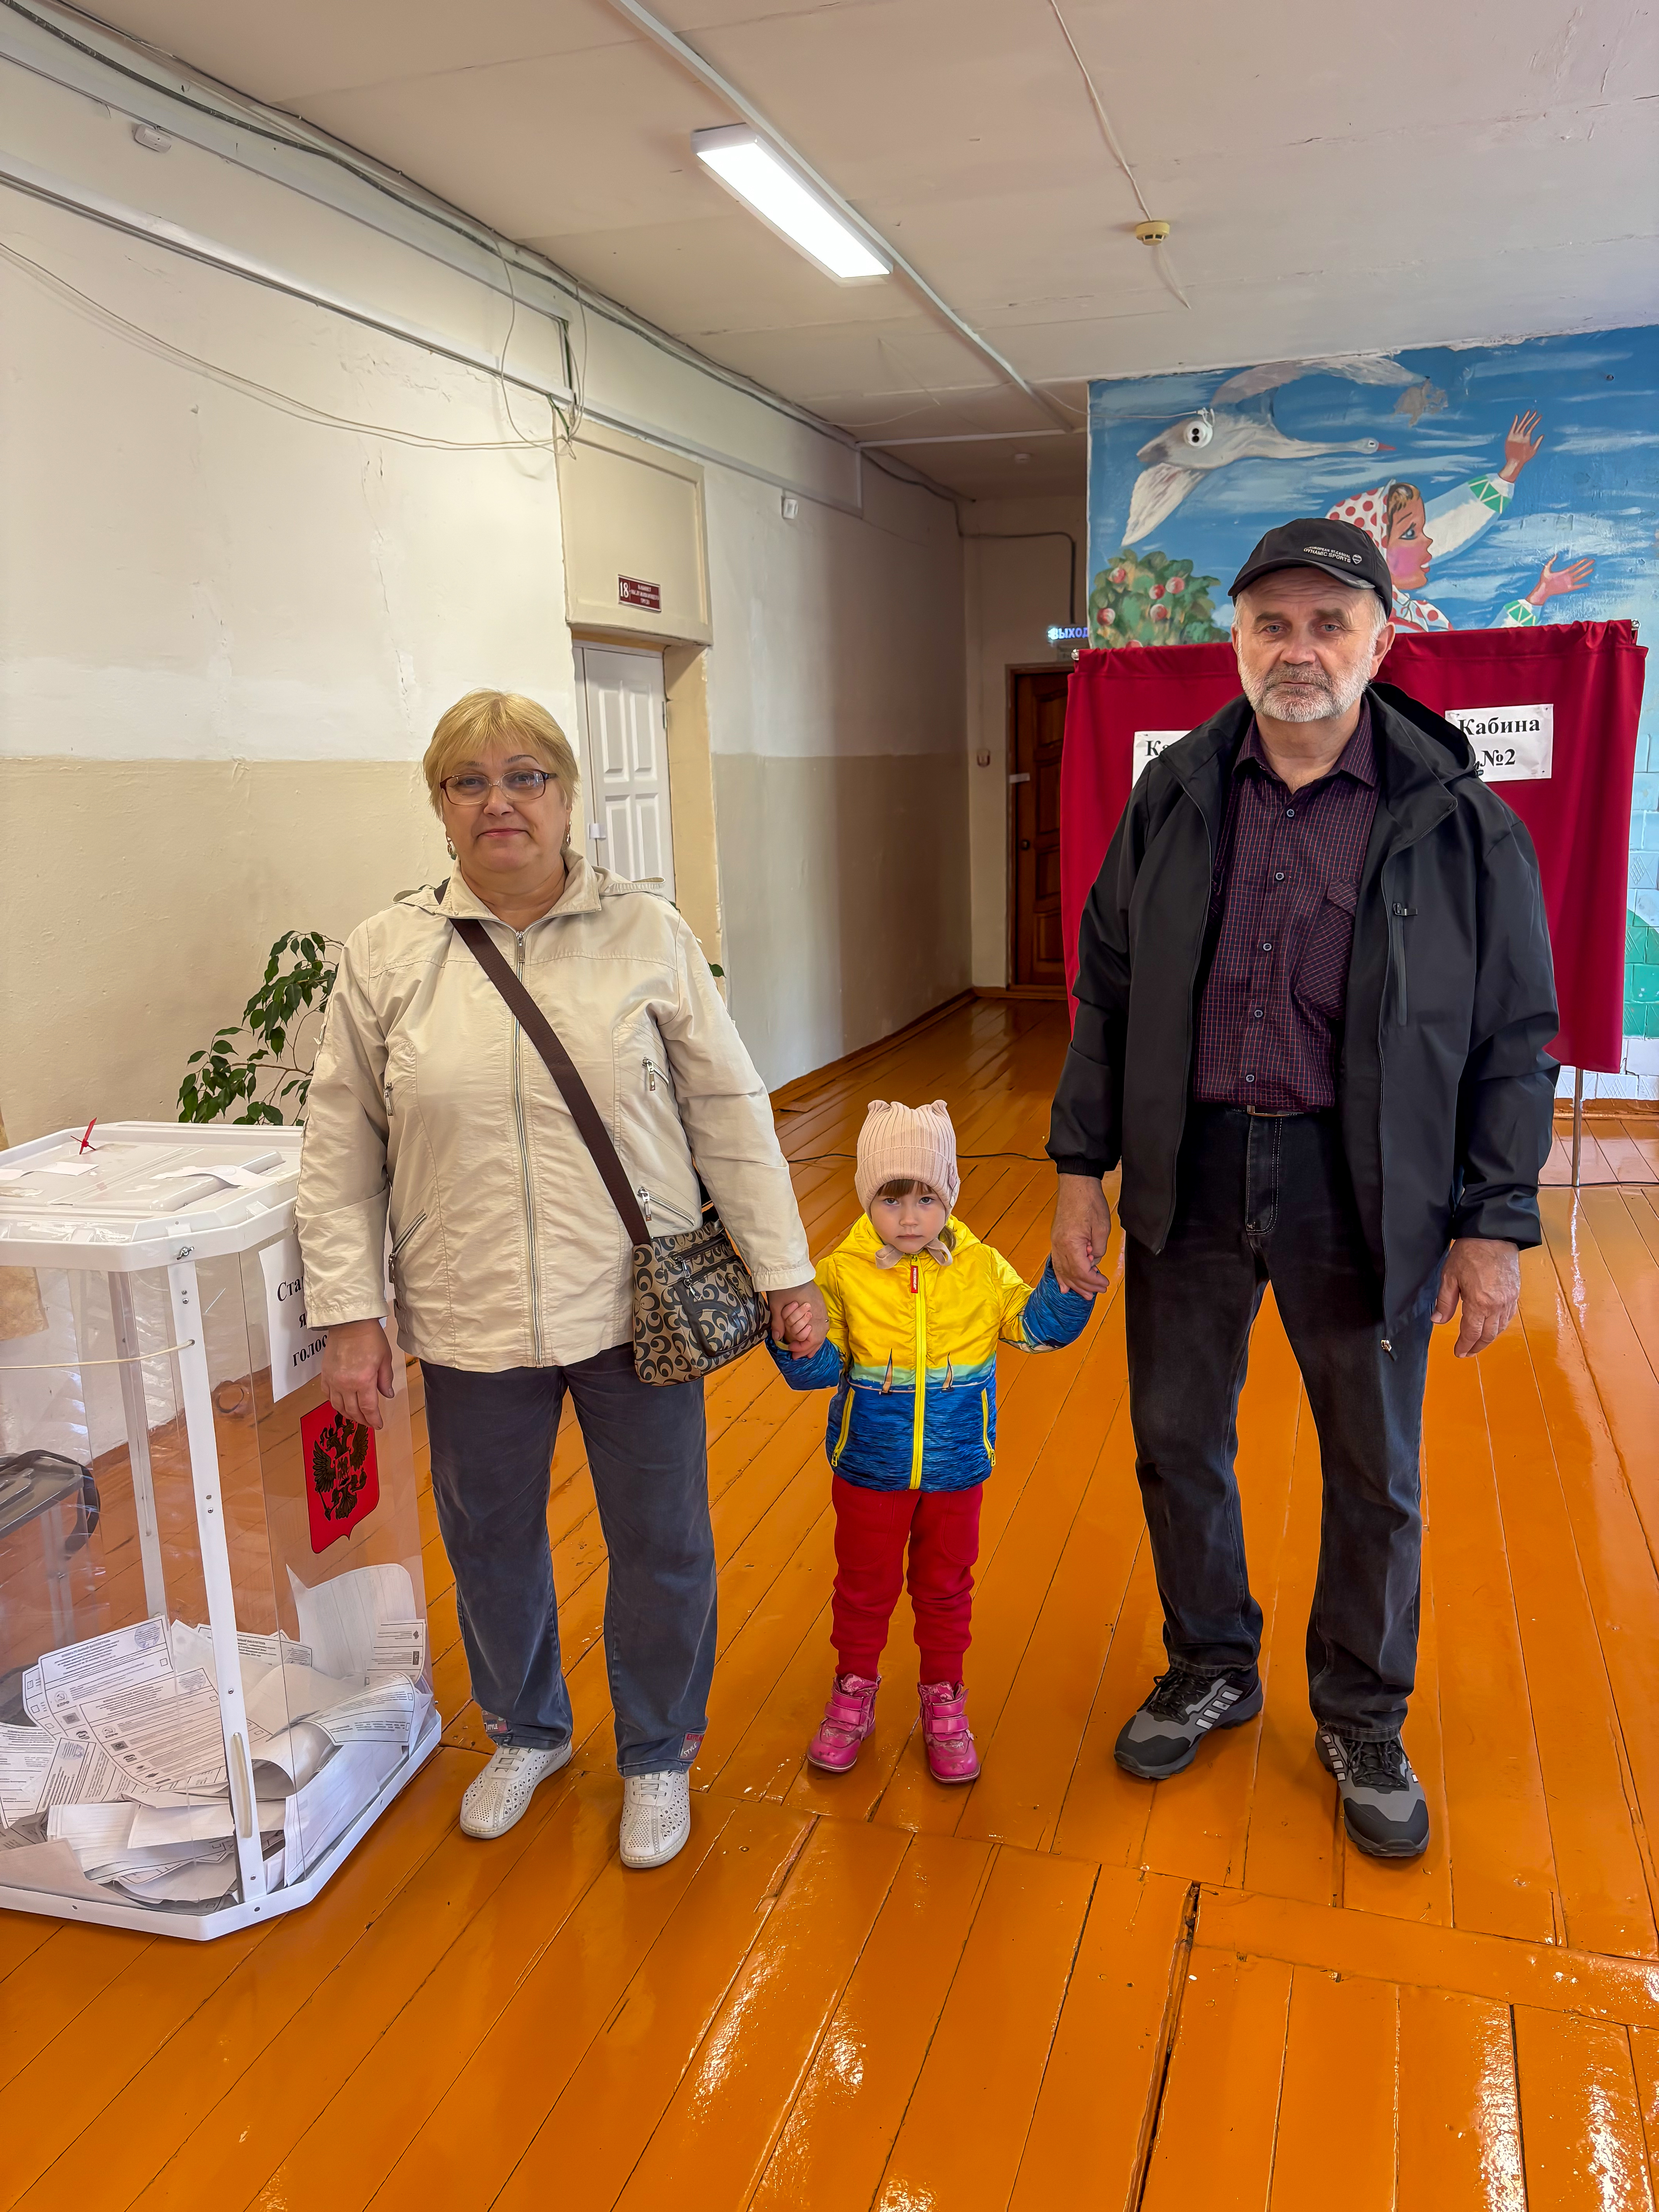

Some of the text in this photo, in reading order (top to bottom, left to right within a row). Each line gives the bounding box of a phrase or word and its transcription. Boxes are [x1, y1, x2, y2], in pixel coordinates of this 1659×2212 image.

[1304, 548, 1351, 563] DYNAMIC SPORTS
[620, 582, 629, 598] 18
[1458, 717, 1540, 735] Кабина
[1480, 749, 1515, 767] №2
[684, 1741, 697, 1757] STYLE
